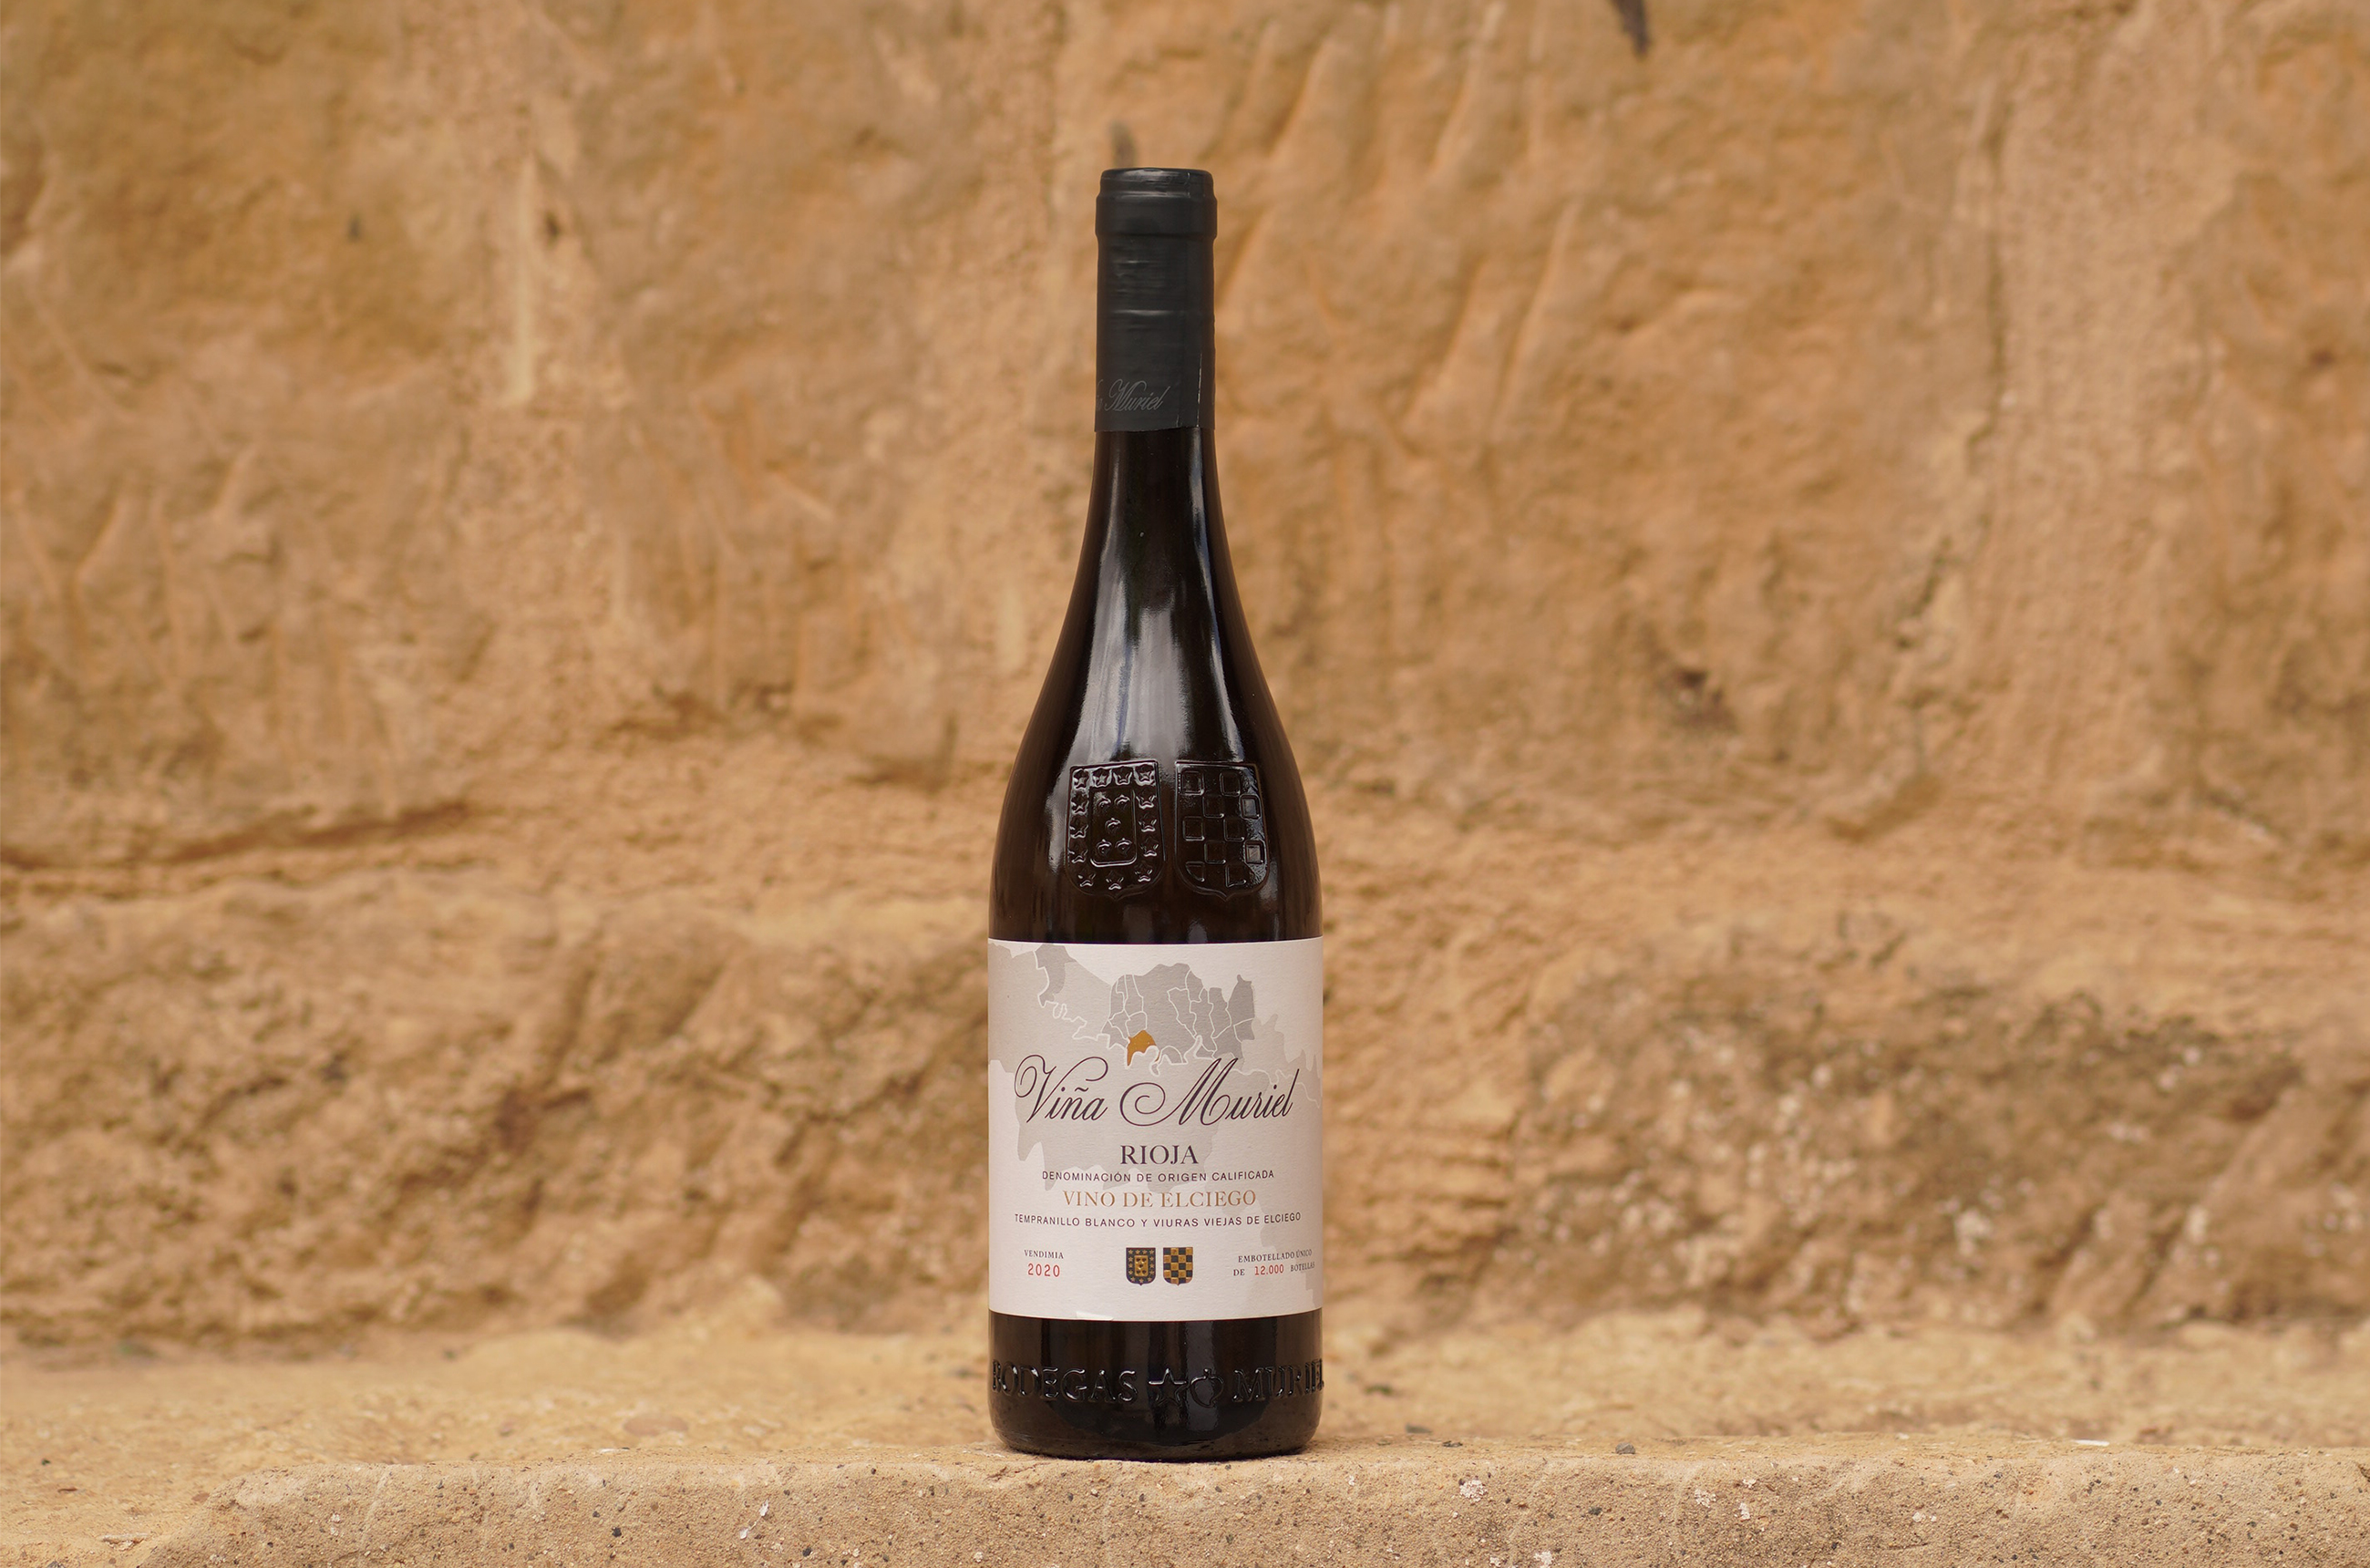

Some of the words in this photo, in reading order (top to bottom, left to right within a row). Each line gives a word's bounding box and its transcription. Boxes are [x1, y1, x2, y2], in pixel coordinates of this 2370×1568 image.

[1105, 378, 1171, 412] Muriel
[1014, 1054, 1109, 1124] Viña
[1119, 1057, 1301, 1127] Muriel
[1119, 1144, 1200, 1165] RIOJA
[1042, 1170, 1130, 1182] DENOMINACIÓN
[1136, 1172, 1153, 1182] DE
[1158, 1171, 1208, 1182] ORIGEN
[1211, 1170, 1274, 1181] CALIFICADA
[1062, 1190, 1116, 1208] VINO
[1122, 1191, 1154, 1208] DE
[1161, 1190, 1257, 1208] ELCIEGO
[1015, 1213, 1080, 1227] TEMPRANILLO
[1085, 1217, 1136, 1228] BLANCO
[1140, 1218, 1148, 1228] Y
[1153, 1217, 1200, 1228] VIURAS
[1204, 1215, 1242, 1227] VIEJAS
[1246, 1214, 1261, 1225] DE
[1264, 1212, 1302, 1224] ELCIEGO
[1024, 1249, 1065, 1260] VENDIMIA
[1238, 1250, 1295, 1264] EMBOTELLADO
[1027, 1264, 1061, 1277] 2020
[1232, 1268, 1246, 1277] DE
[1253, 1264, 1284, 1276] 12.000
[1290, 1262, 1315, 1273] BOTELLAS
[992, 1359, 1139, 1404] BODEGAS
